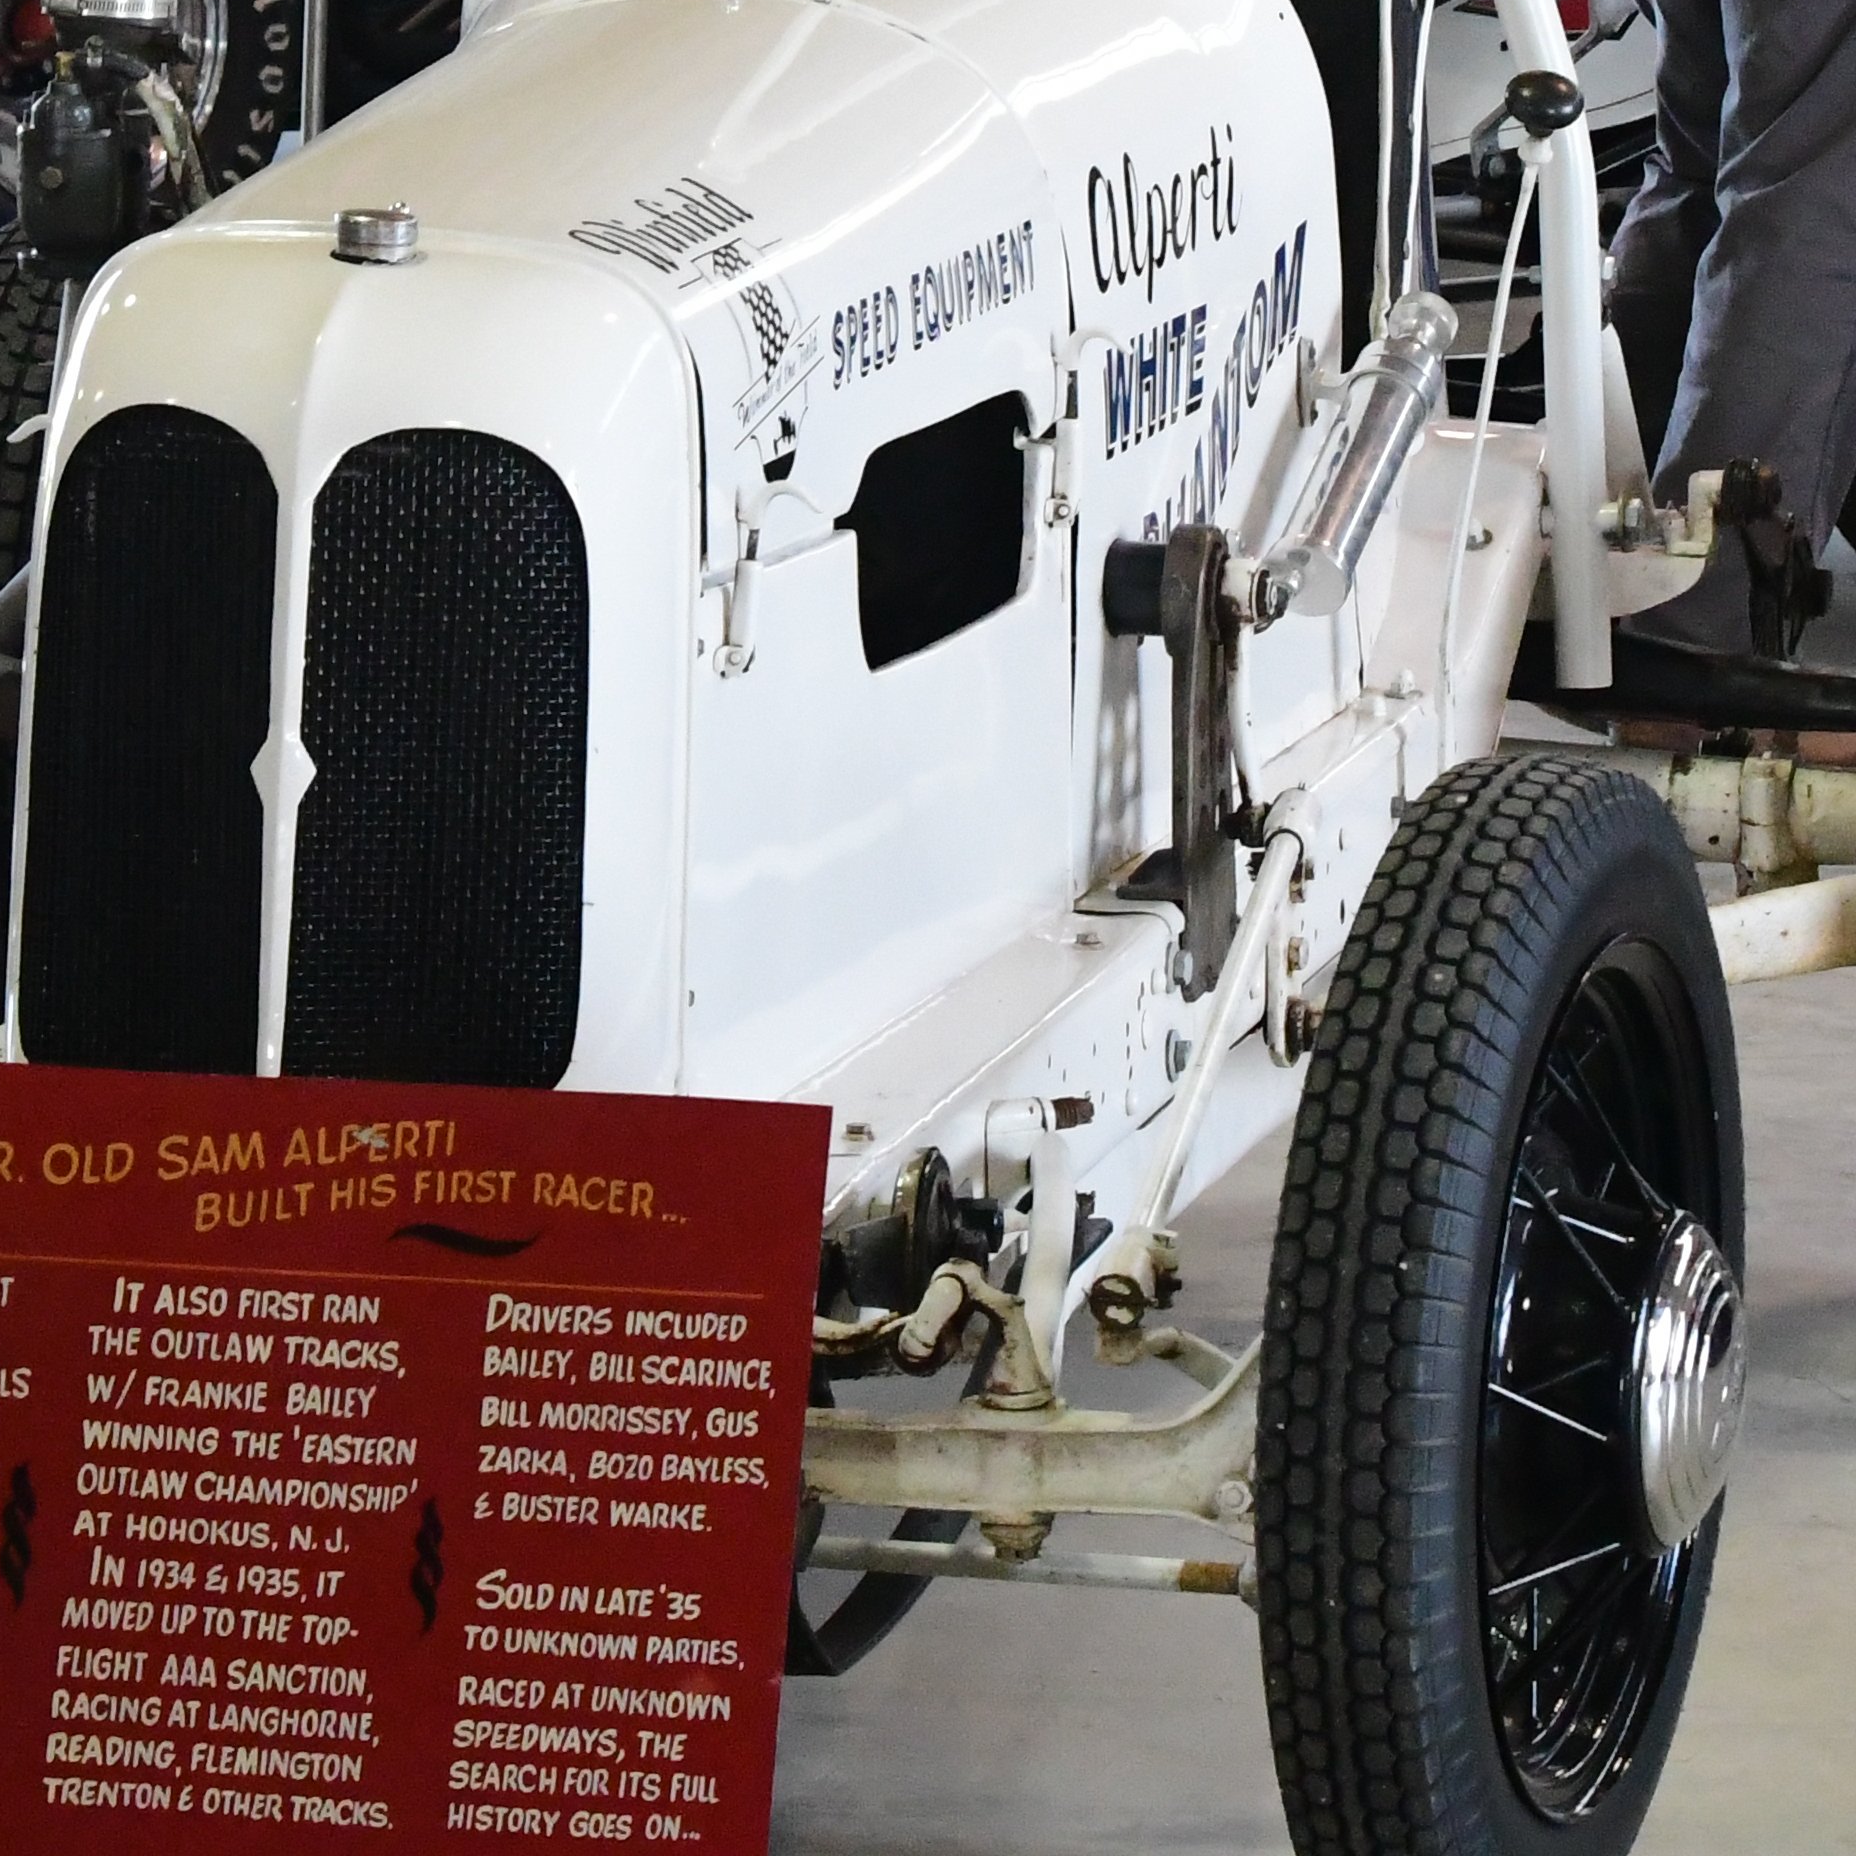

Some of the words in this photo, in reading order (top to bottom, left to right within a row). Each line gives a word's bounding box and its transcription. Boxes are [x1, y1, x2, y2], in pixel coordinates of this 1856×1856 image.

[568, 177, 755, 275] Winfield
[1087, 123, 1243, 304] Alperti
[831, 284, 900, 391] SPEED
[909, 219, 1035, 352] EQUIPMENT
[1103, 302, 1209, 462] WHITE
[44, 1143, 133, 1184] OLD
[159, 1133, 264, 1179] SAM
[285, 1121, 454, 1166] ALPERTI
[196, 1184, 314, 1230] BUILT
[332, 1174, 395, 1210] HIS
[415, 1172, 515, 1203] FIRST
[114, 1277, 144, 1313] IT
[154, 1285, 227, 1316] ALSO
[238, 1289, 314, 1321] FIRST
[323, 1294, 379, 1323] RAN
[486, 1294, 612, 1335] DRIVERS
[626, 1311, 747, 1341] INCLUDED
[89, 1326, 141, 1355] THE
[151, 1328, 273, 1364] OUTLAW
[284, 1336, 405, 1378] TRACKS,
[484, 1346, 575, 1384] BAILEY,
[590, 1352, 635, 1382] BILL
[642, 1356, 774, 1398] SCARINCE,
[88, 1369, 136, 1409] W/
[145, 1376, 267, 1412] FRANKIE
[286, 1383, 376, 1418] BAILEY
[481, 1396, 531, 1427] BILL
[539, 1402, 697, 1440] MORRISSEY,
[706, 1408, 758, 1437] GUS
[83, 1420, 219, 1455] WINNING
[232, 1431, 283, 1460] THE
[78, 1463, 188, 1499] OUTLAW
[479, 1445, 575, 1482] ZARKA,
[588, 1451, 653, 1480] BOZO
[661, 1454, 768, 1488] BAYLESS,
[74, 1510, 112, 1537] AT
[126, 1514, 277, 1551] HOHOKUS,
[290, 1526, 317, 1550] N.
[474, 1492, 493, 1519] &
[503, 1492, 599, 1524] BUSTER
[611, 1500, 711, 1531] WARKE.
[91, 1546, 125, 1587] IN
[138, 1559, 195, 1589] 1934
[205, 1565, 228, 1593] &
[238, 1566, 306, 1602] 1935,
[317, 1571, 344, 1597] IT
